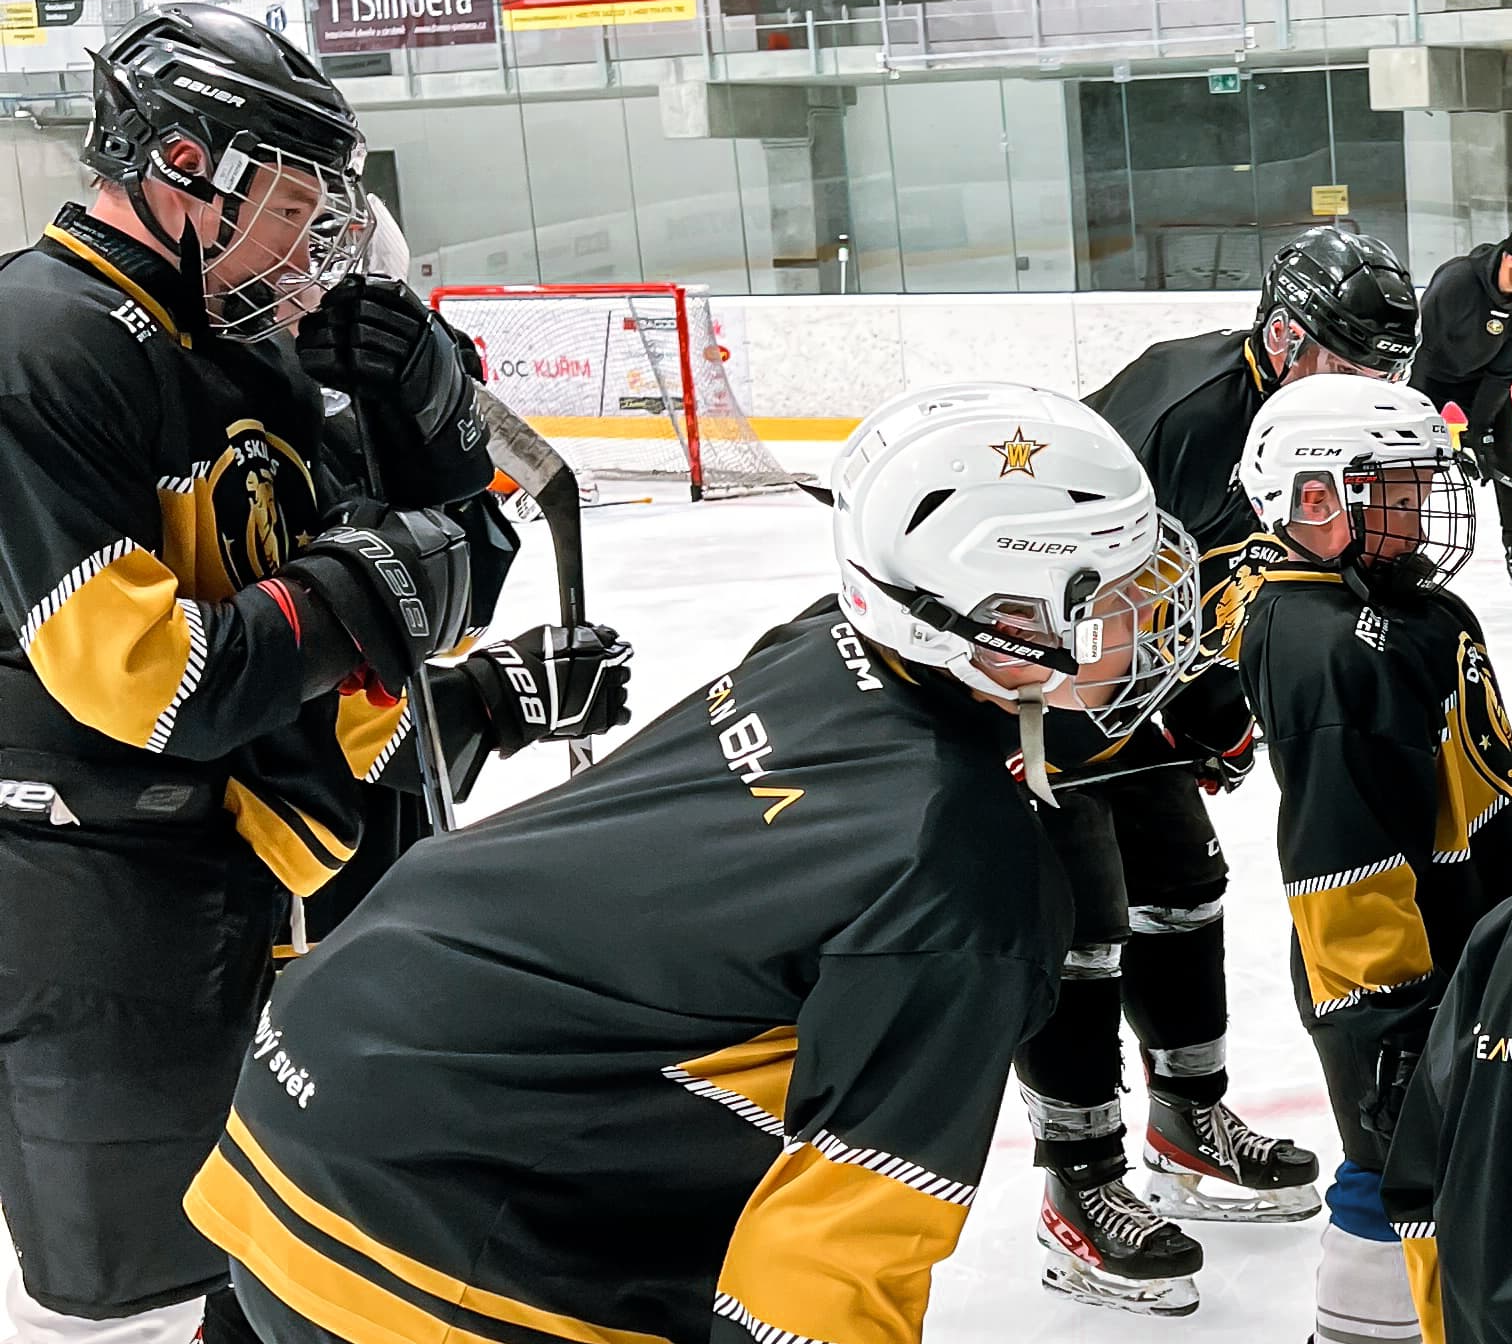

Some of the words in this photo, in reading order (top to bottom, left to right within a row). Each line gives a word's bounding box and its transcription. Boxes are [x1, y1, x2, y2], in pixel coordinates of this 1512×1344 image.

[1376, 340, 1413, 354] CCM
[1432, 424, 1446, 433] CC
[1007, 444, 1032, 468] W
[1294, 448, 1342, 457] CCM
[830, 622, 884, 692] CCM
